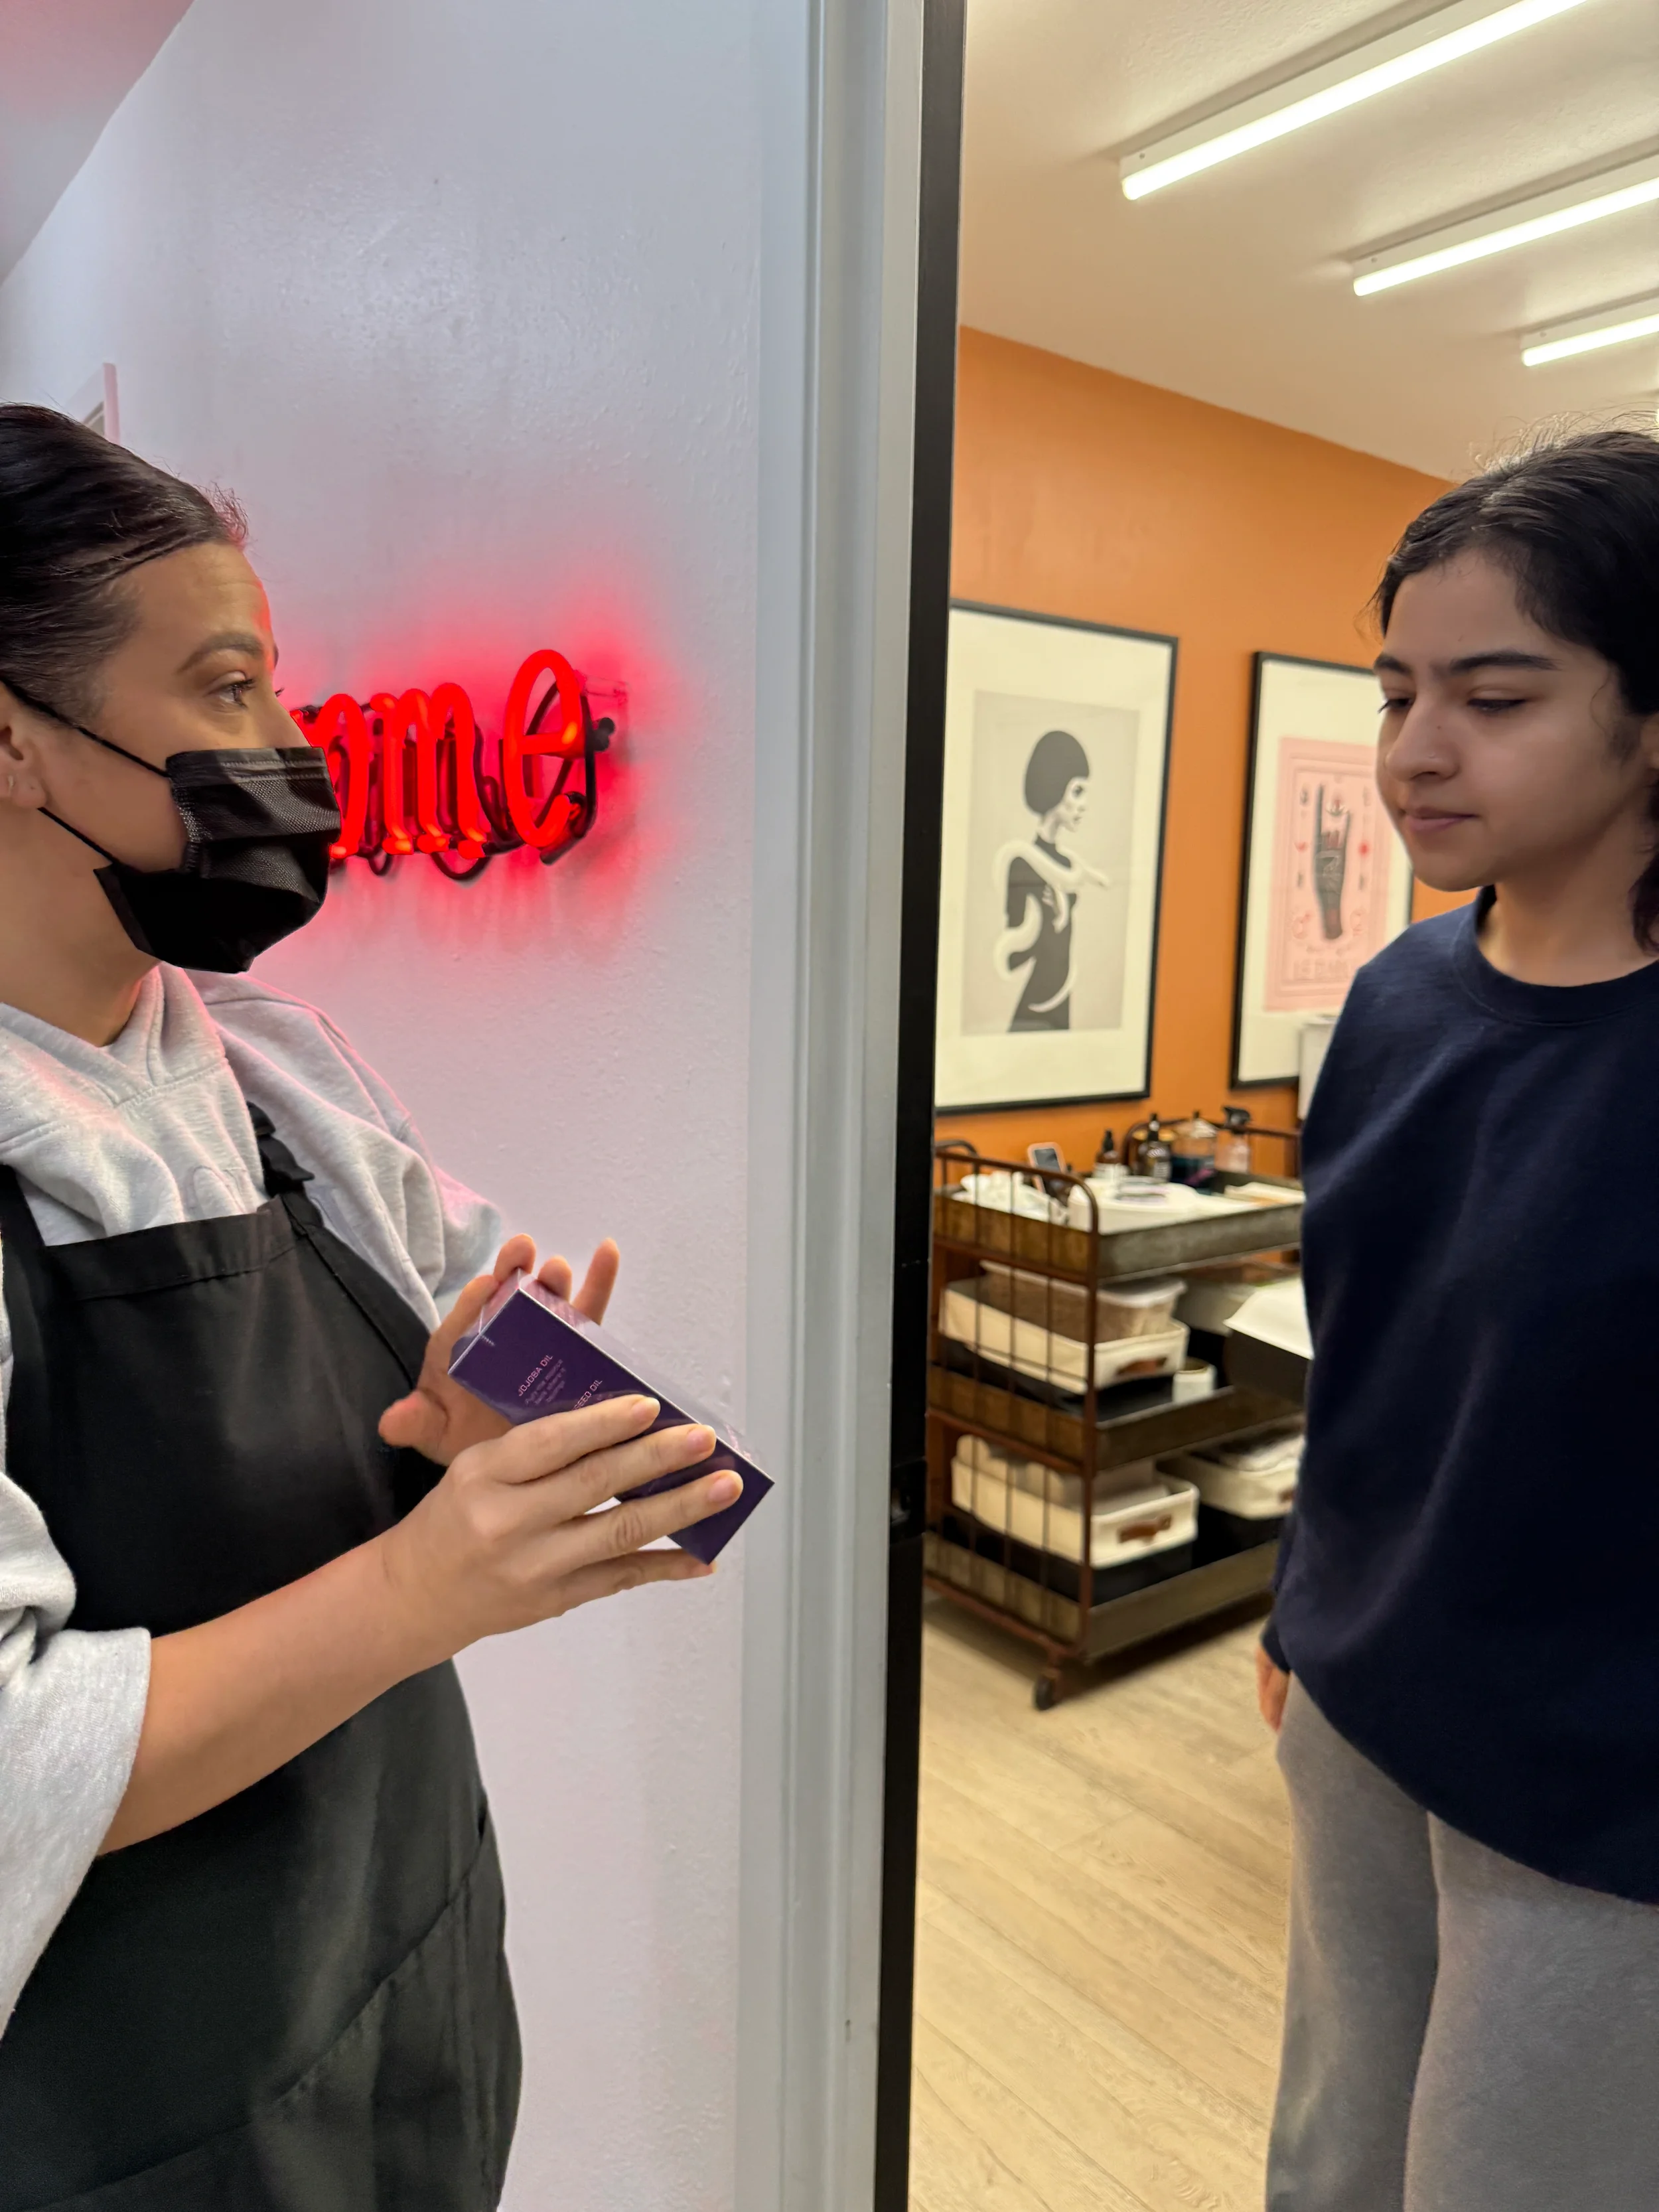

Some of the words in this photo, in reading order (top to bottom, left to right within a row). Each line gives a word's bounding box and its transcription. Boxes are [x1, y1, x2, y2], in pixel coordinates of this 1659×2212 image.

[518, 1367, 543, 1396] JOJOBA
[540, 1355, 553, 1367] OIL
[573, 1391, 592, 1410] SEED
[589, 1380, 603, 1392] OIL
